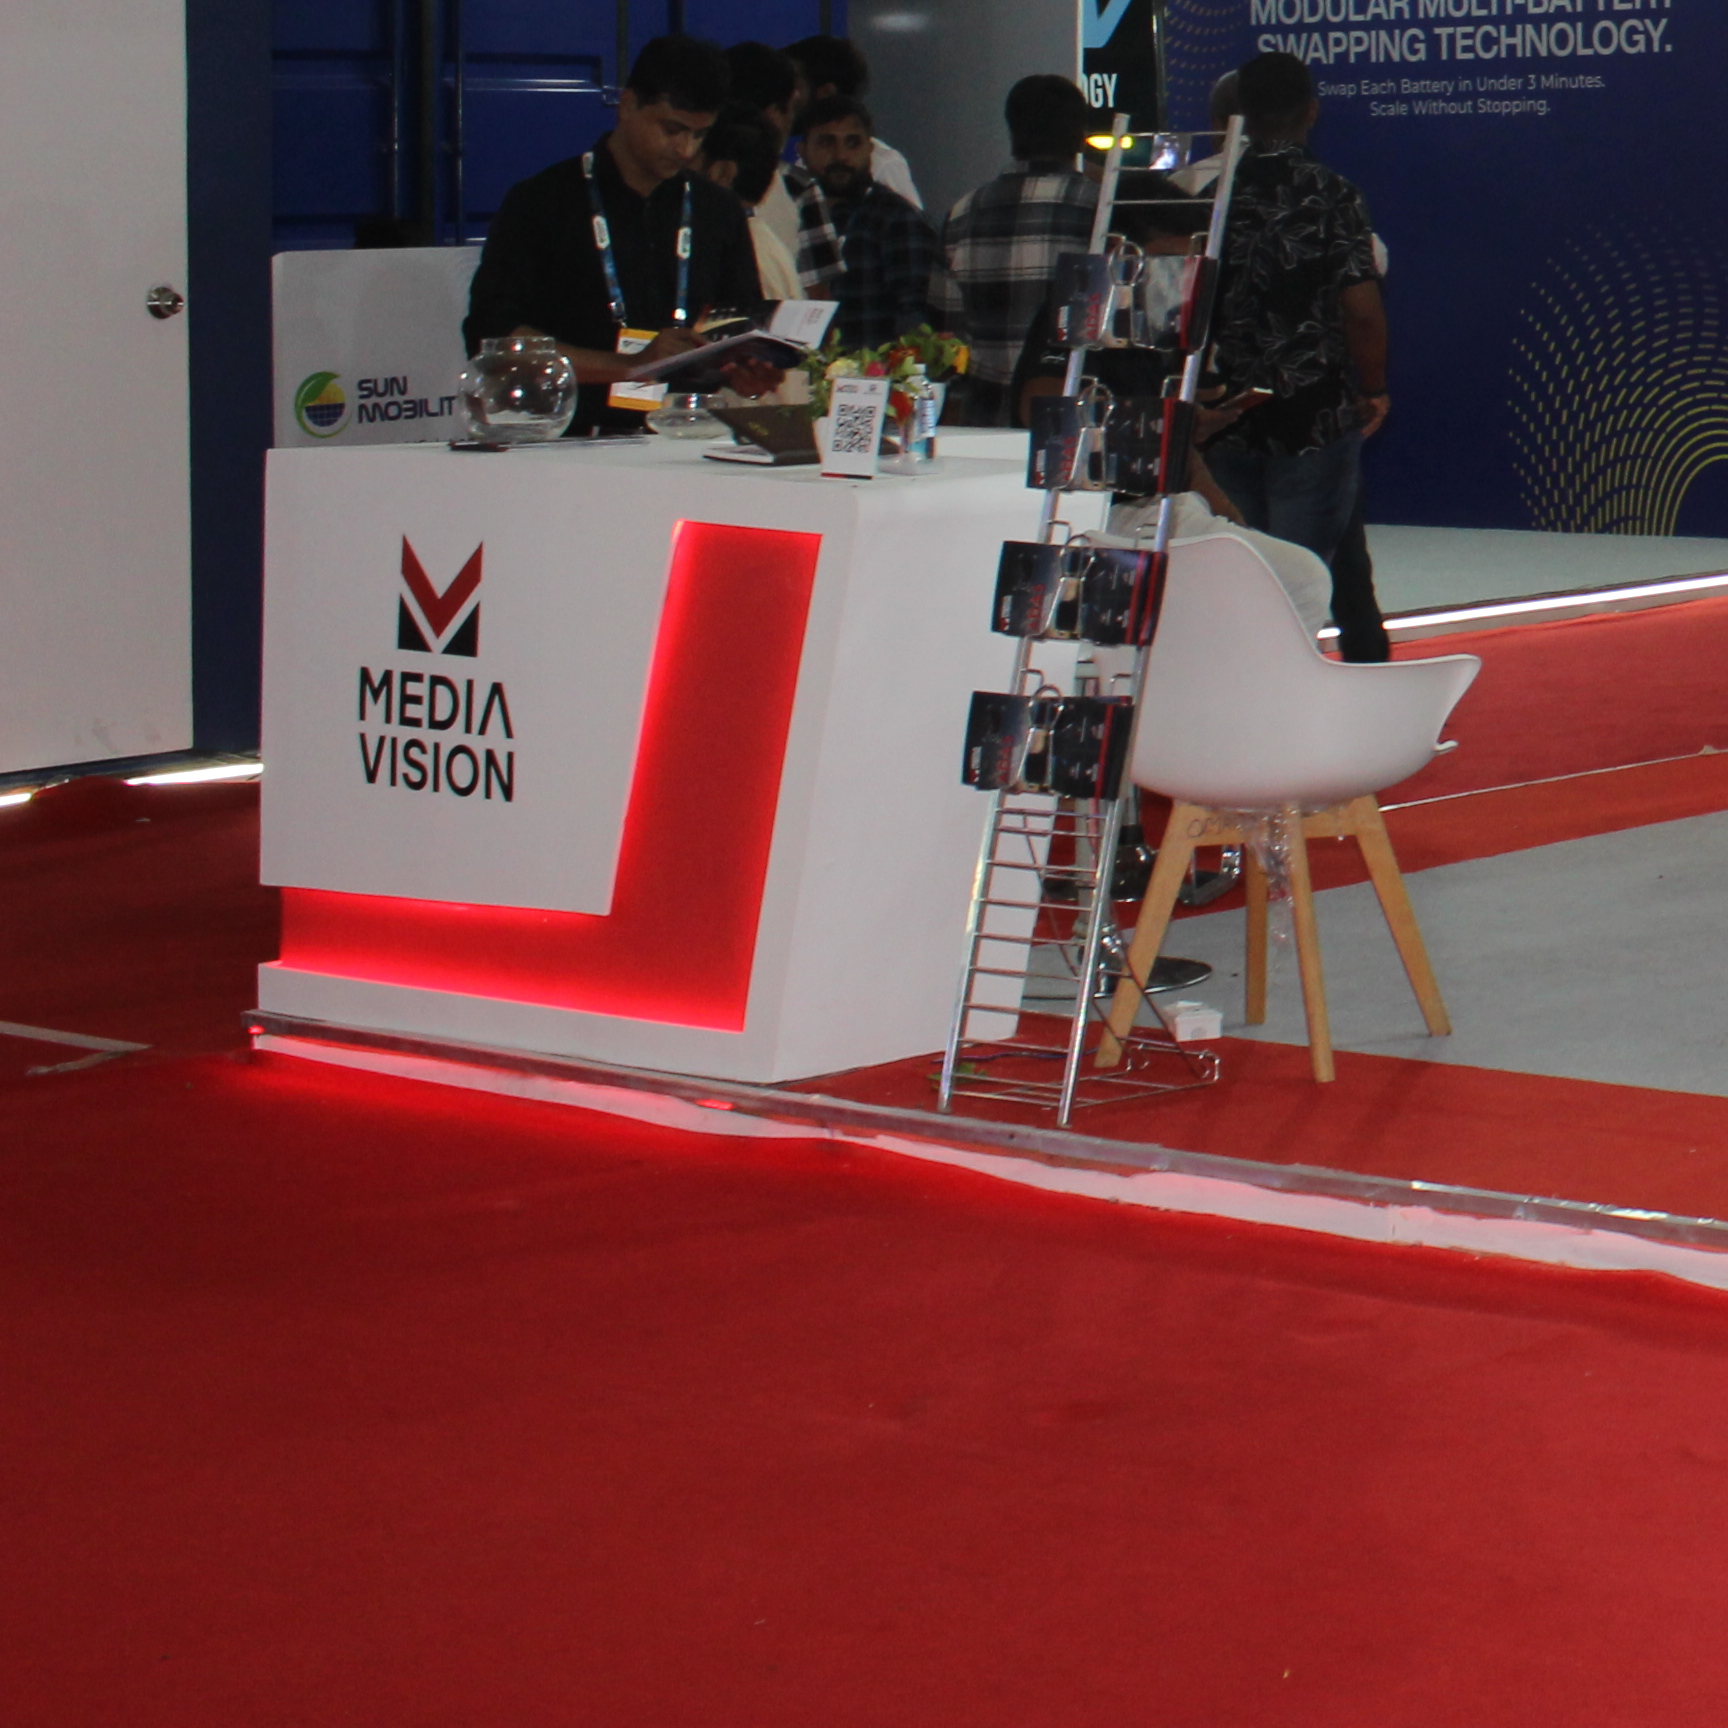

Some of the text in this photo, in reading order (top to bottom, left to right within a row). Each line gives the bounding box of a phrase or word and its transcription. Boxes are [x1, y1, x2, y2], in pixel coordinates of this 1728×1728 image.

[1433, 18, 1673, 61] TECHNOLOGY.
[1317, 72, 1606, 99] Swap Each Battery in Under 3 Minutes.
[1369, 96, 1551, 117] Scale Without Stopping.
[357, 375, 408, 399] SUN
[357, 395, 457, 424] MOBILIT
[359, 666, 514, 740] MEDIA
[359, 731, 515, 803] VISION
